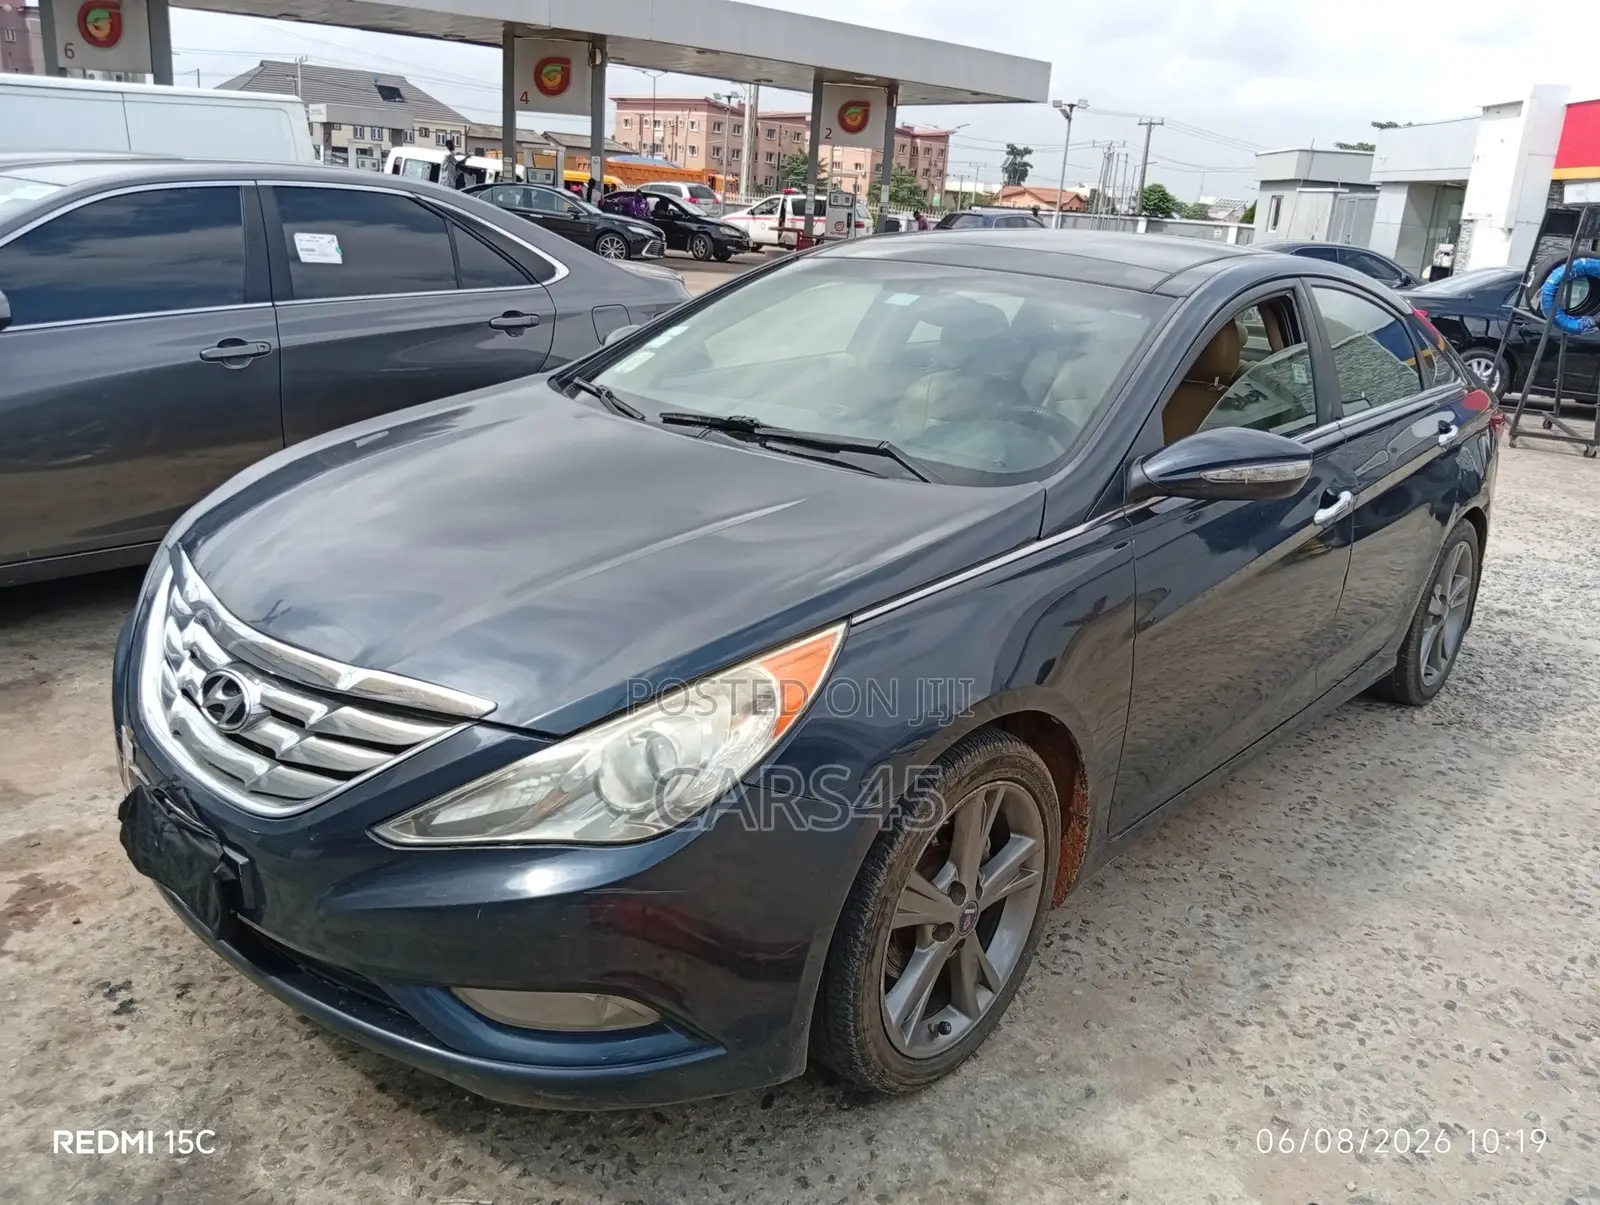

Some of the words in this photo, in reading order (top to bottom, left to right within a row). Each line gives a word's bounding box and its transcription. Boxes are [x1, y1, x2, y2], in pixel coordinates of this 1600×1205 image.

[64, 42, 75, 60] 6
[519, 91, 530, 105] 4
[824, 127, 832, 140] 2
